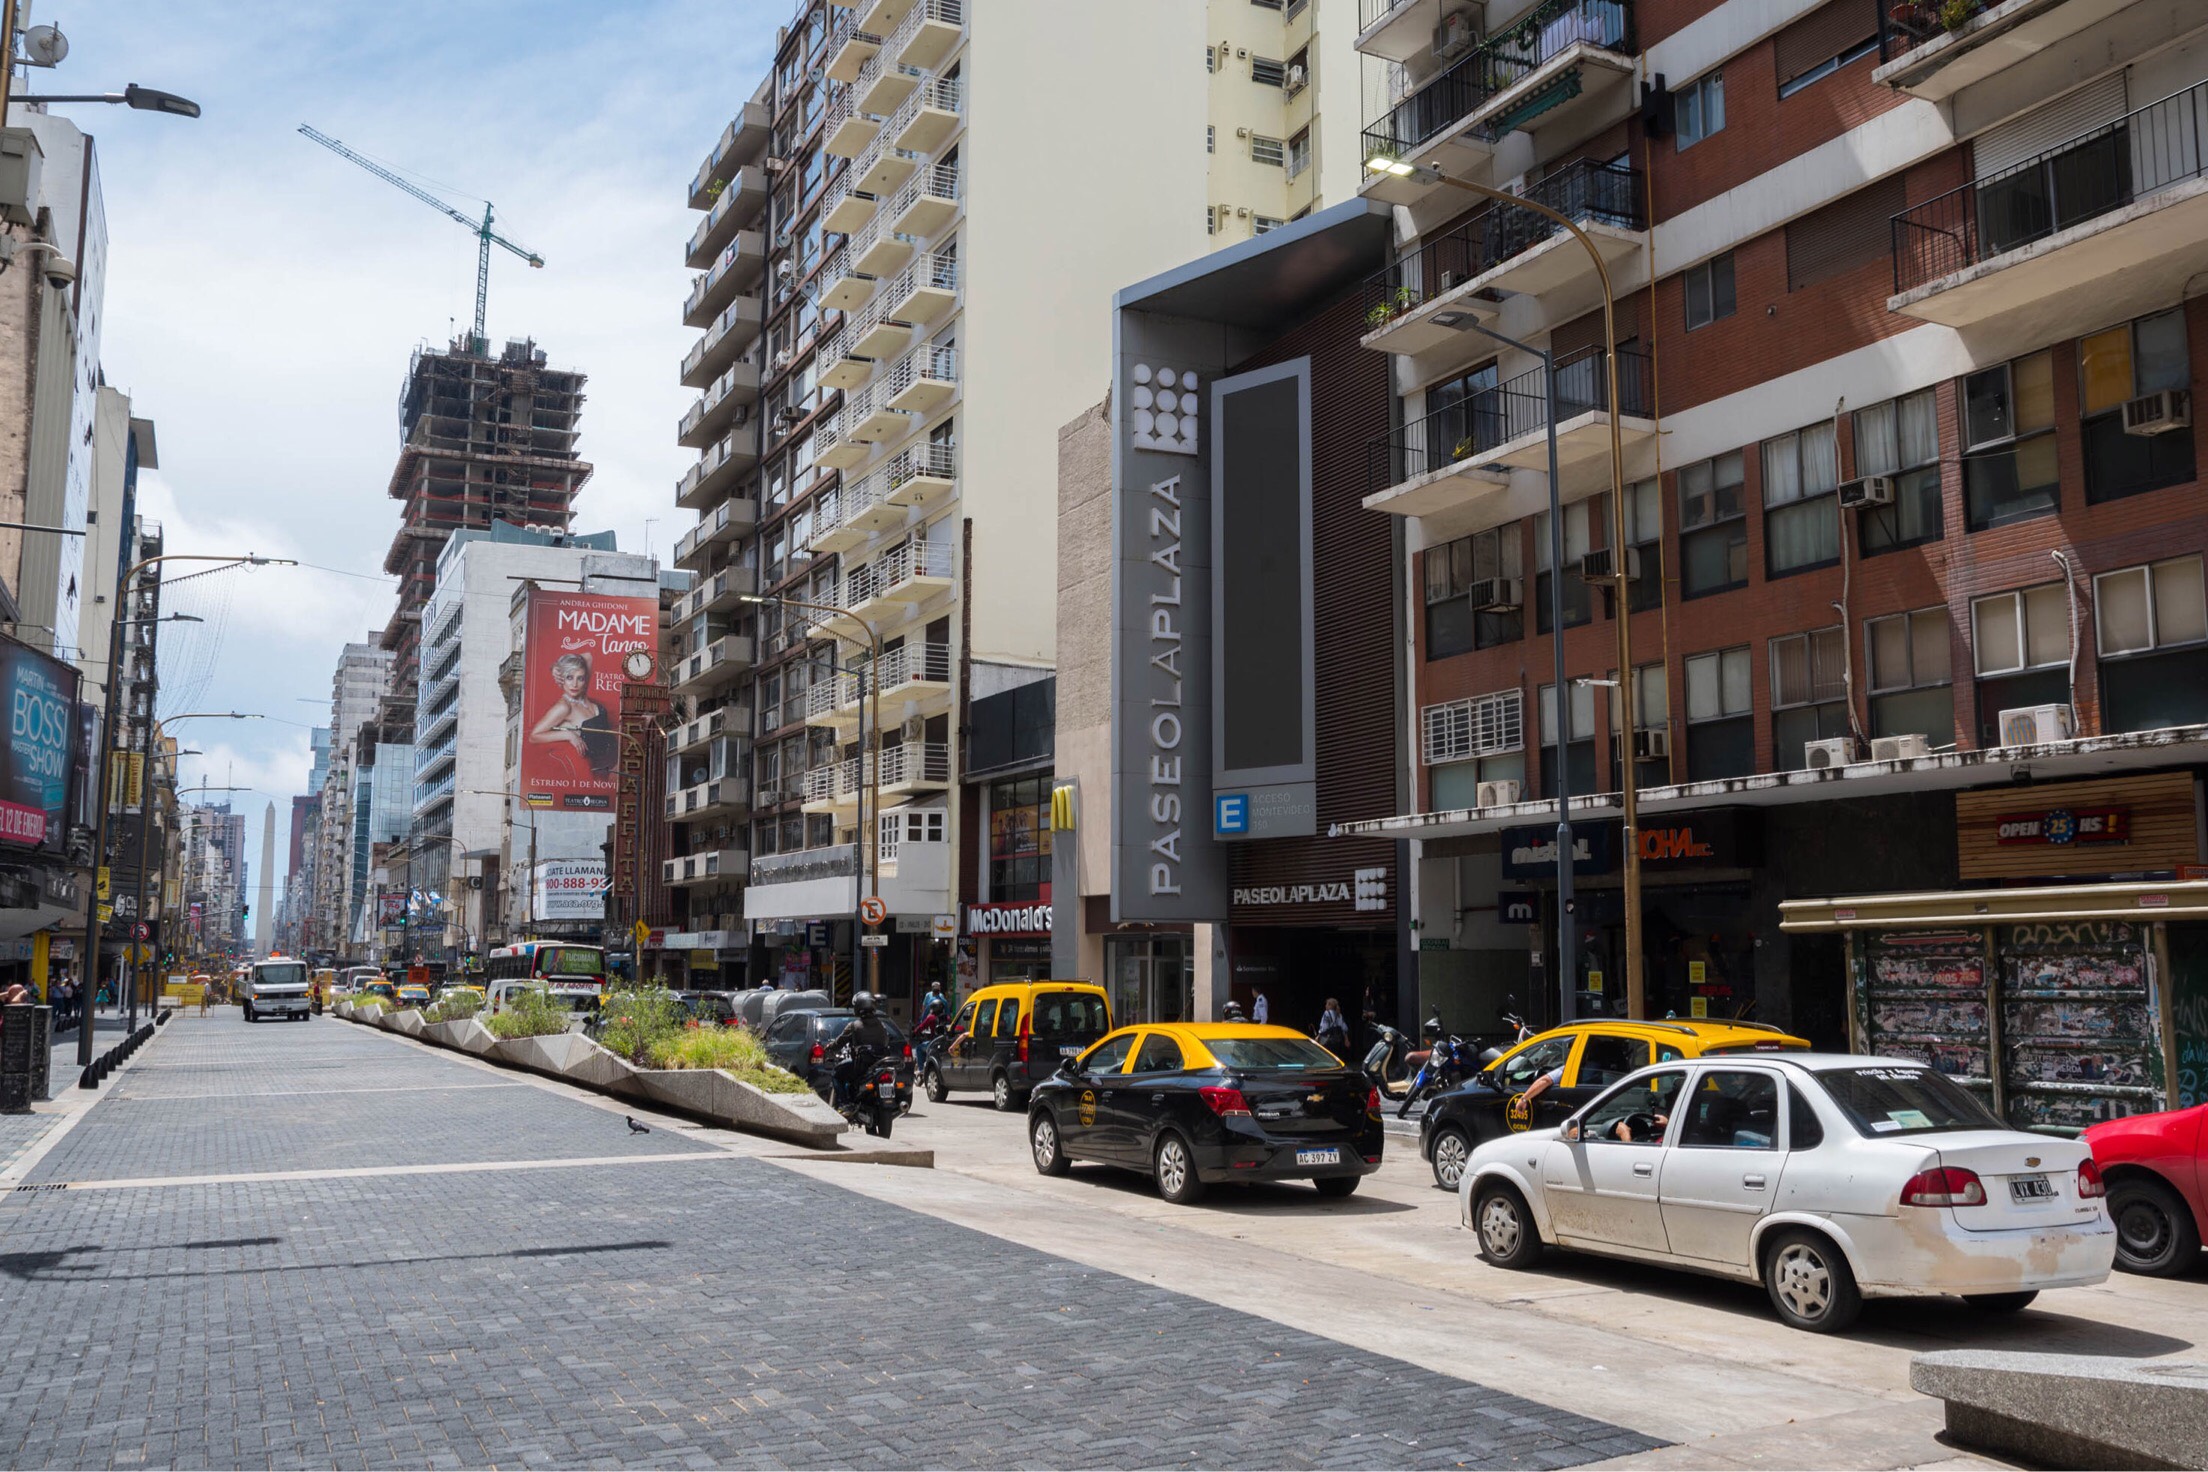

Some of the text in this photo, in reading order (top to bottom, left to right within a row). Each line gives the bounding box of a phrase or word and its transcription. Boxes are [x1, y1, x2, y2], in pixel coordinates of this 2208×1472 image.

[560, 599, 628, 611] ANDREA GHIDONE
[558, 609, 651, 636] MADAME
[595, 632, 649, 655] Tango
[16, 665, 45, 691] MARTIN
[595, 671, 625, 681] TEATRO
[1151, 474, 1183, 896] PASEOLAPLAZA
[12, 687, 69, 751] BOSSI
[28, 744, 65, 780] SHOW
[530, 777, 570, 788] ESTRENO
[579, 780, 591, 788] DE
[1252, 792, 1291, 804] ACCESO
[1220, 799, 1241, 829] E
[1251, 803, 1310, 819] MONTEVIDEO
[5, 808, 14, 833] 12
[14, 810, 22, 835] DE
[22, 811, 44, 839] ENERO!
[1999, 820, 2041, 837] OPEN
[2050, 818, 2068, 834] 25
[2078, 816, 2103, 832] HS
[470, 877, 480, 888] C
[1233, 882, 1351, 905] PASEOLAPLAZA
[969, 905, 1053, 933] McDonald's
[810, 925, 825, 946] E
[565, 952, 596, 963] TUCUMÁN
[1299, 1153, 1310, 1164] AC
[1311, 1153, 1326, 1163] 397
[2011, 1180, 2052, 1198] LVX 430
